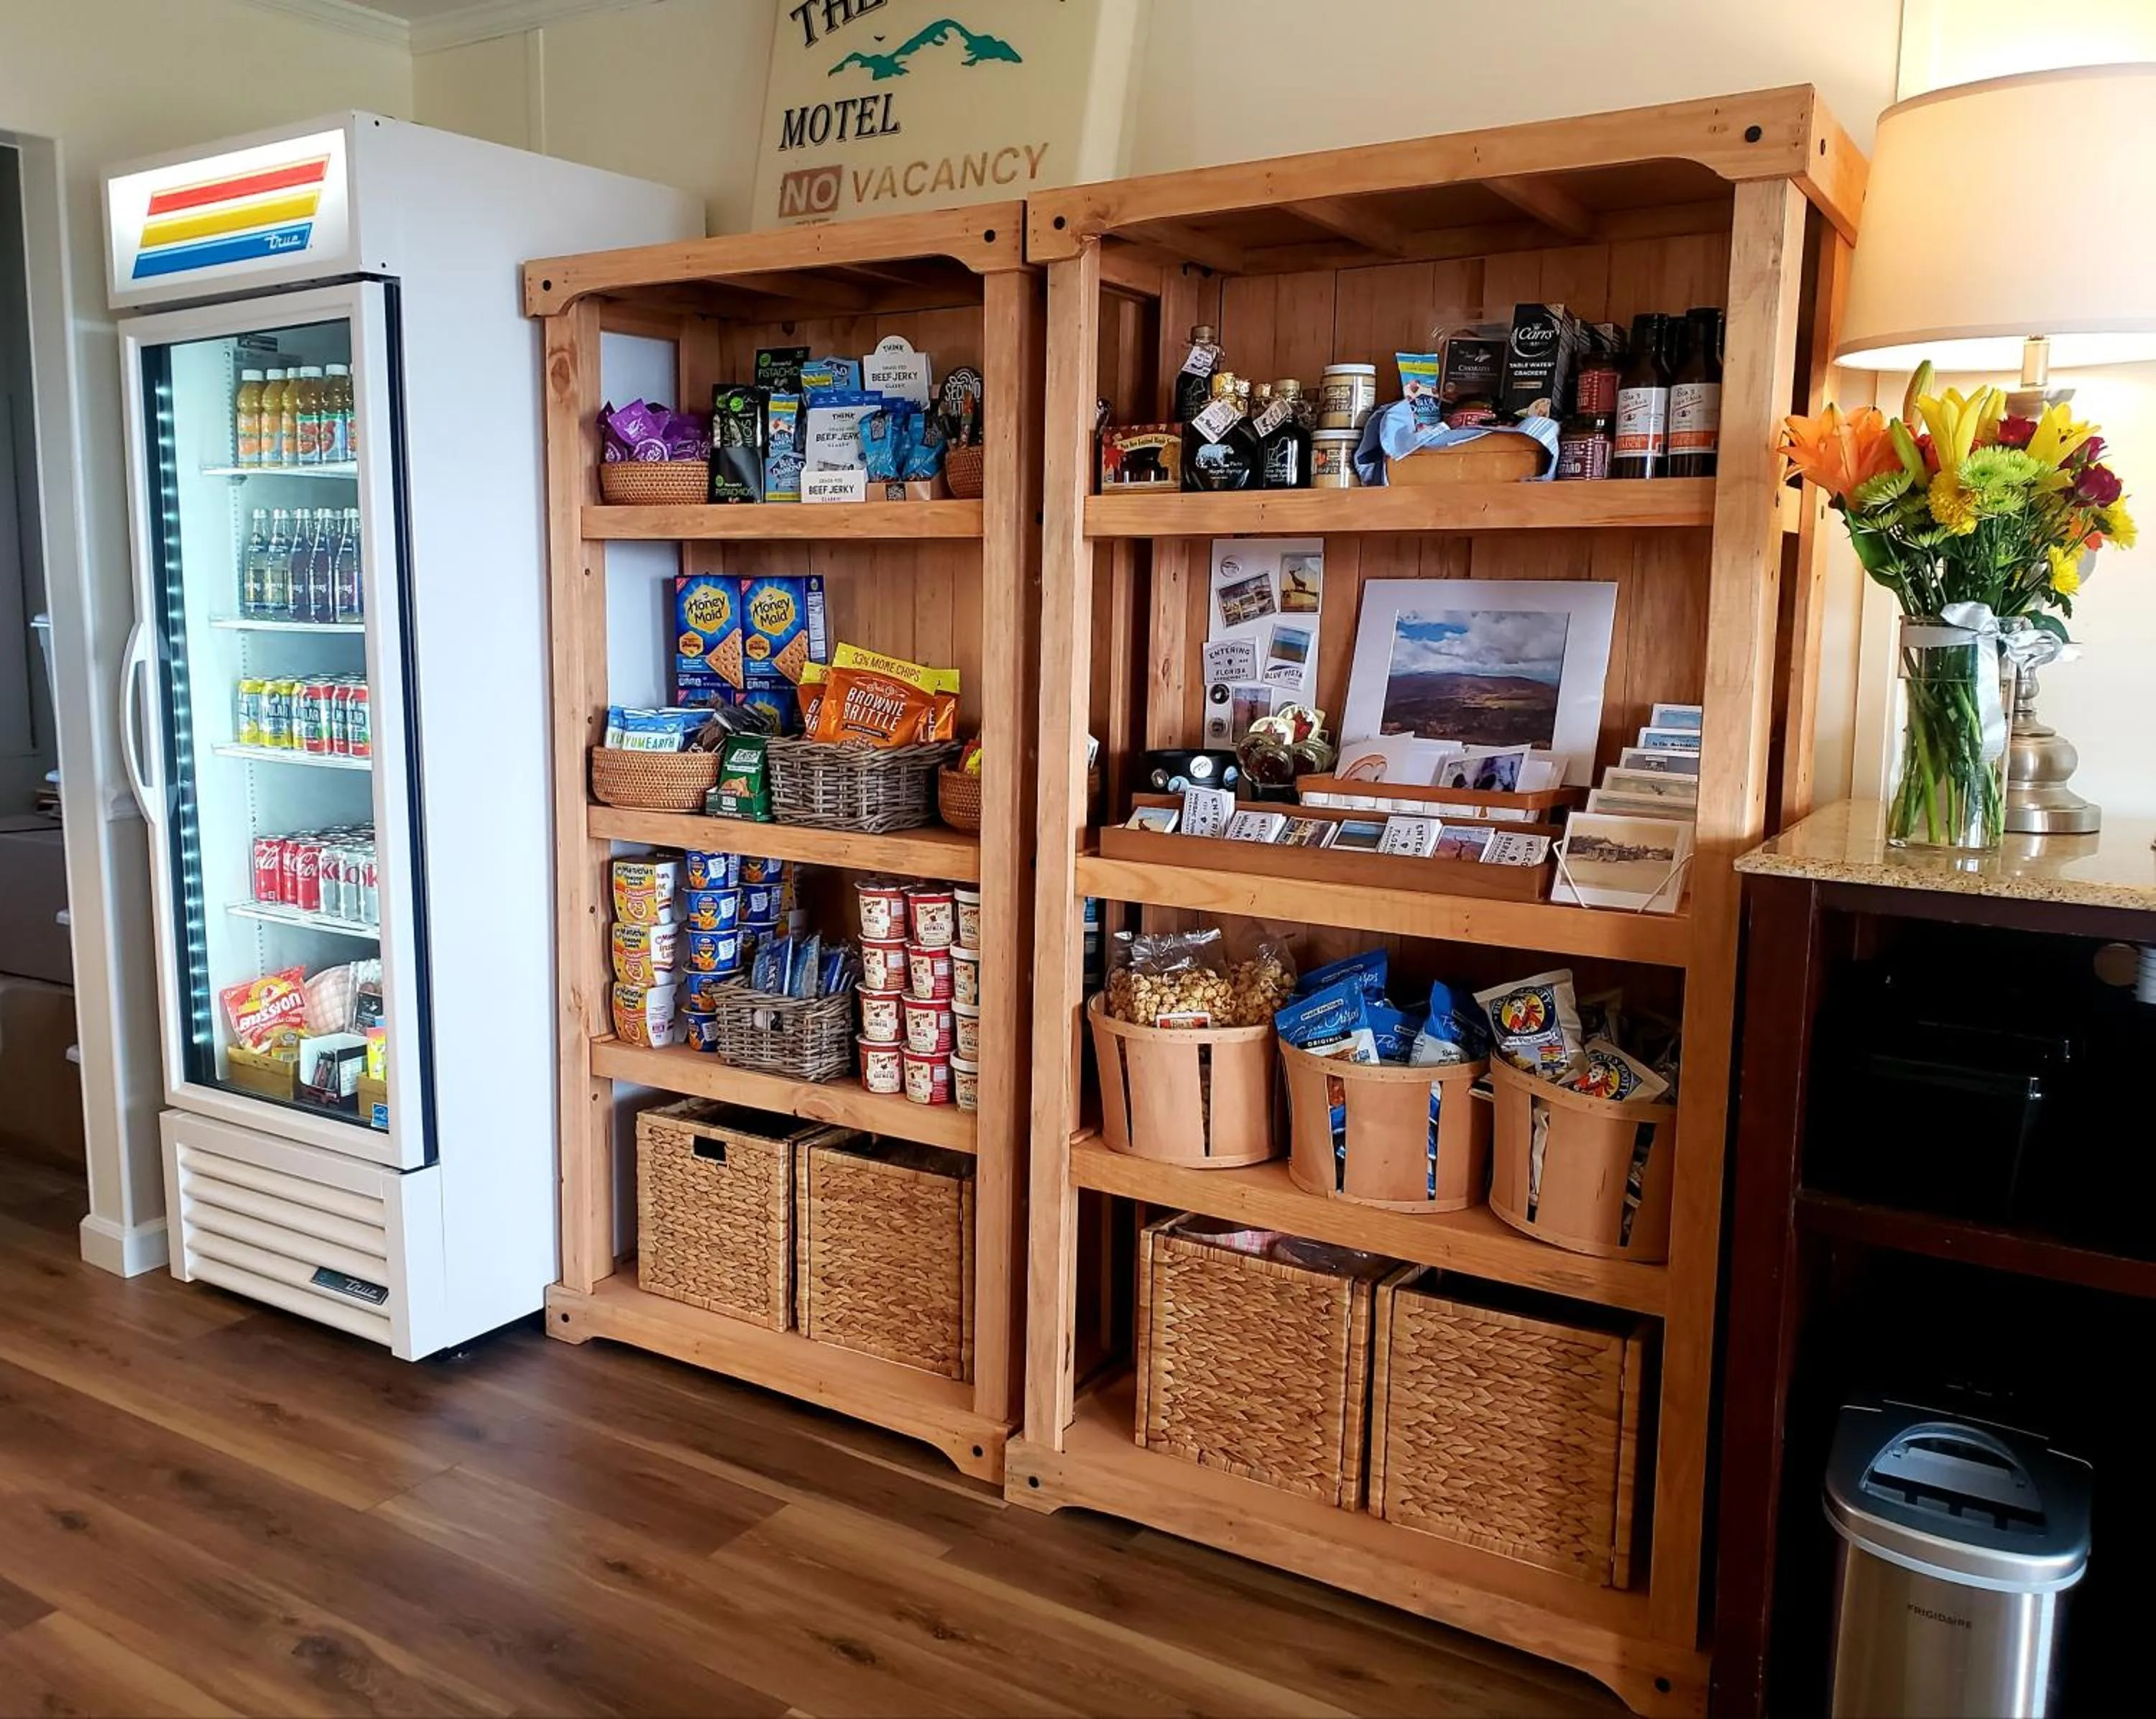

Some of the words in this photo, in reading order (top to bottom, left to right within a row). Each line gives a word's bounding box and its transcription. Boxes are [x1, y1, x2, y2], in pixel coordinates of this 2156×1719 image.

[778, 93, 901, 152] MOTEL
[780, 174, 840, 215] NO
[852, 143, 1049, 203] VACANCY
[758, 366, 799, 379] PISTACHIO
[872, 372, 892, 382] BEEF
[892, 372, 918, 381] JERKY
[816, 433, 837, 442] BEEF
[837, 432, 860, 441] JERK
[808, 485, 828, 495] BEEF
[829, 484, 855, 494] JERKY
[687, 596, 725, 614] Honey
[752, 598, 791, 619] Honey
[694, 608, 722, 625] Maid
[760, 609, 788, 627] Maid
[852, 652, 869, 666] 33%
[870, 657, 896, 673] MORE
[895, 663, 921, 682] CHIPS
[847, 686, 907, 716] BROWNIE
[843, 702, 902, 732] BRITTLE
[1307, 1035, 1343, 1047] ORIGINAL
[1907, 1603, 1973, 1629] FRIGIDAIRE
